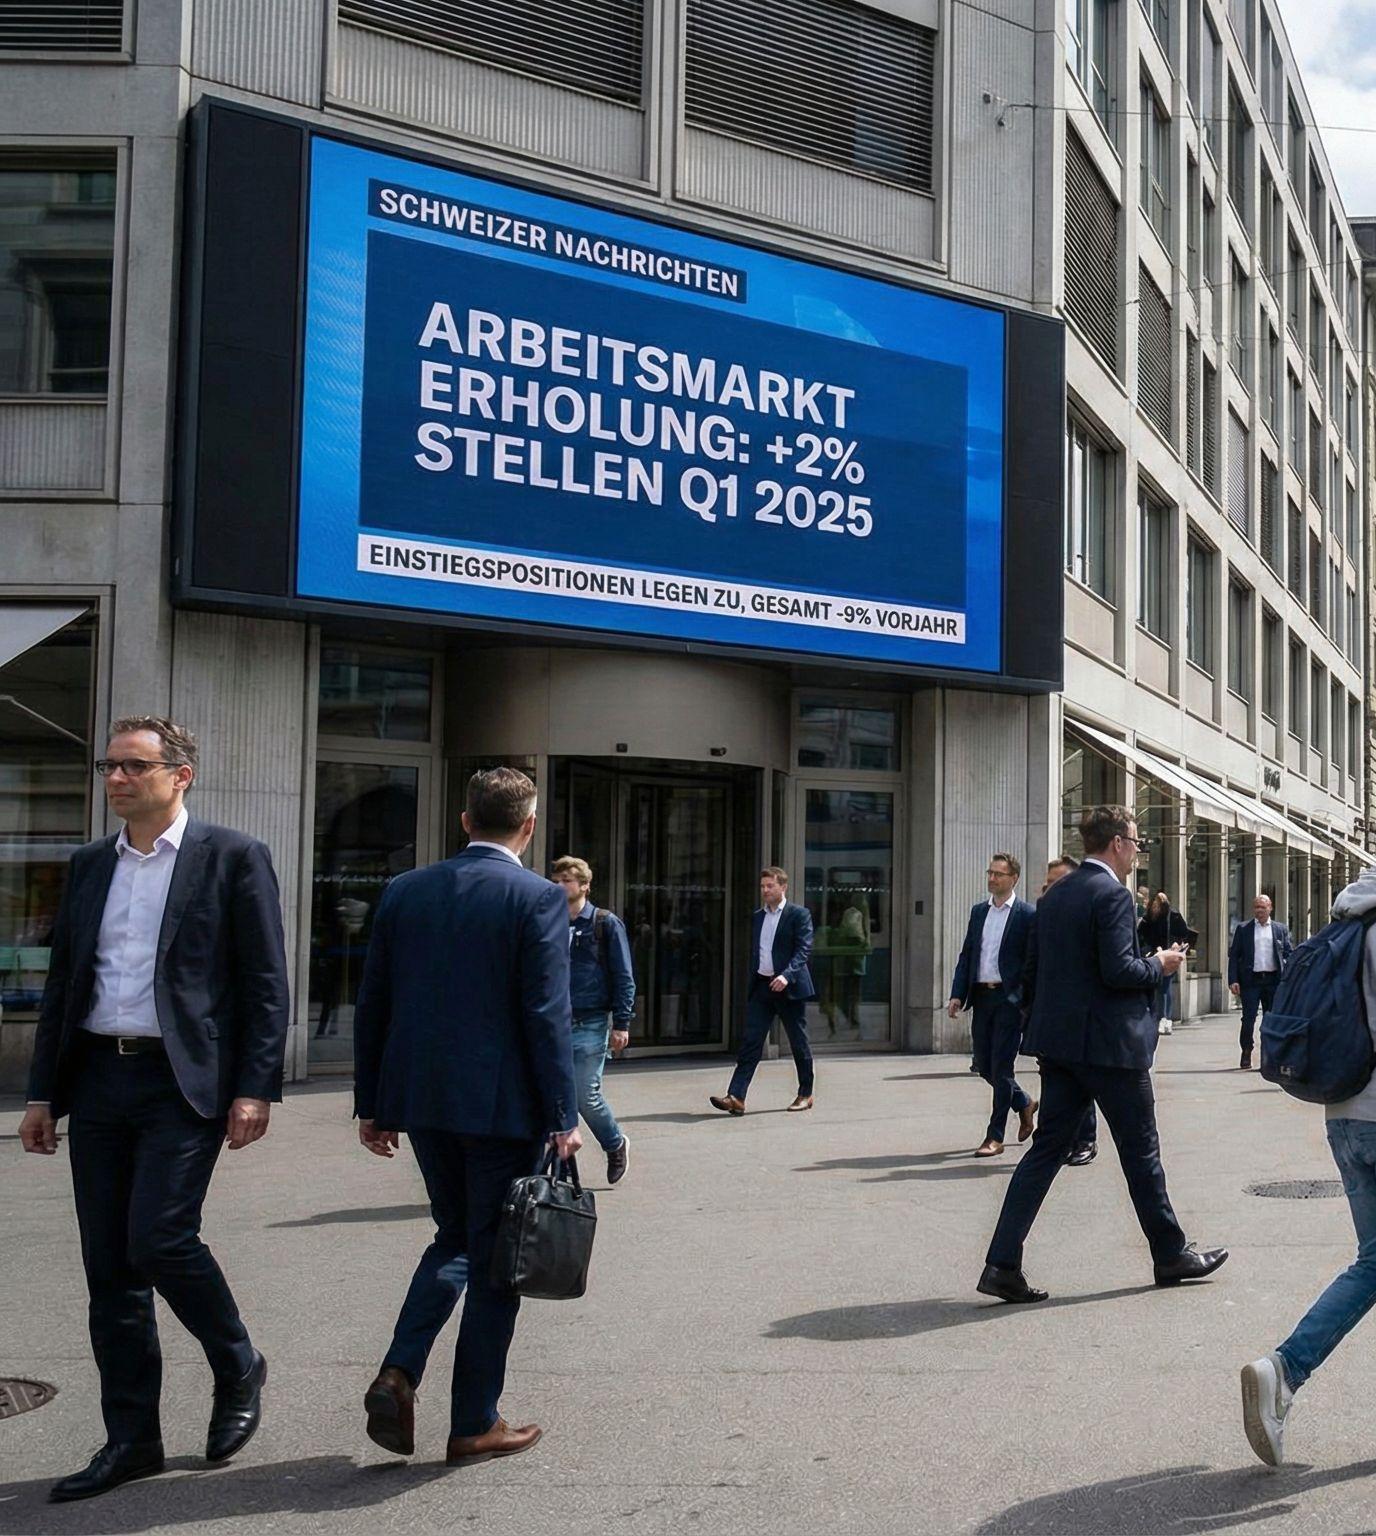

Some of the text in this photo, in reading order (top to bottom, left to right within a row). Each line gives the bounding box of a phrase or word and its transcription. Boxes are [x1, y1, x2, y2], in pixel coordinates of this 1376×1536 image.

[379, 188, 738, 297] SCHWEIZER NACHRICHTEN
[418, 301, 855, 429] ARBEITSMARKT
[420, 360, 865, 485] ERHOLUNG: +2%
[414, 422, 873, 537] STELLEN Q1 2025
[370, 543, 958, 637] EINSTIEGSPOSITIONEN LEGEN ZU, GESAMT -9% VORJAHR
